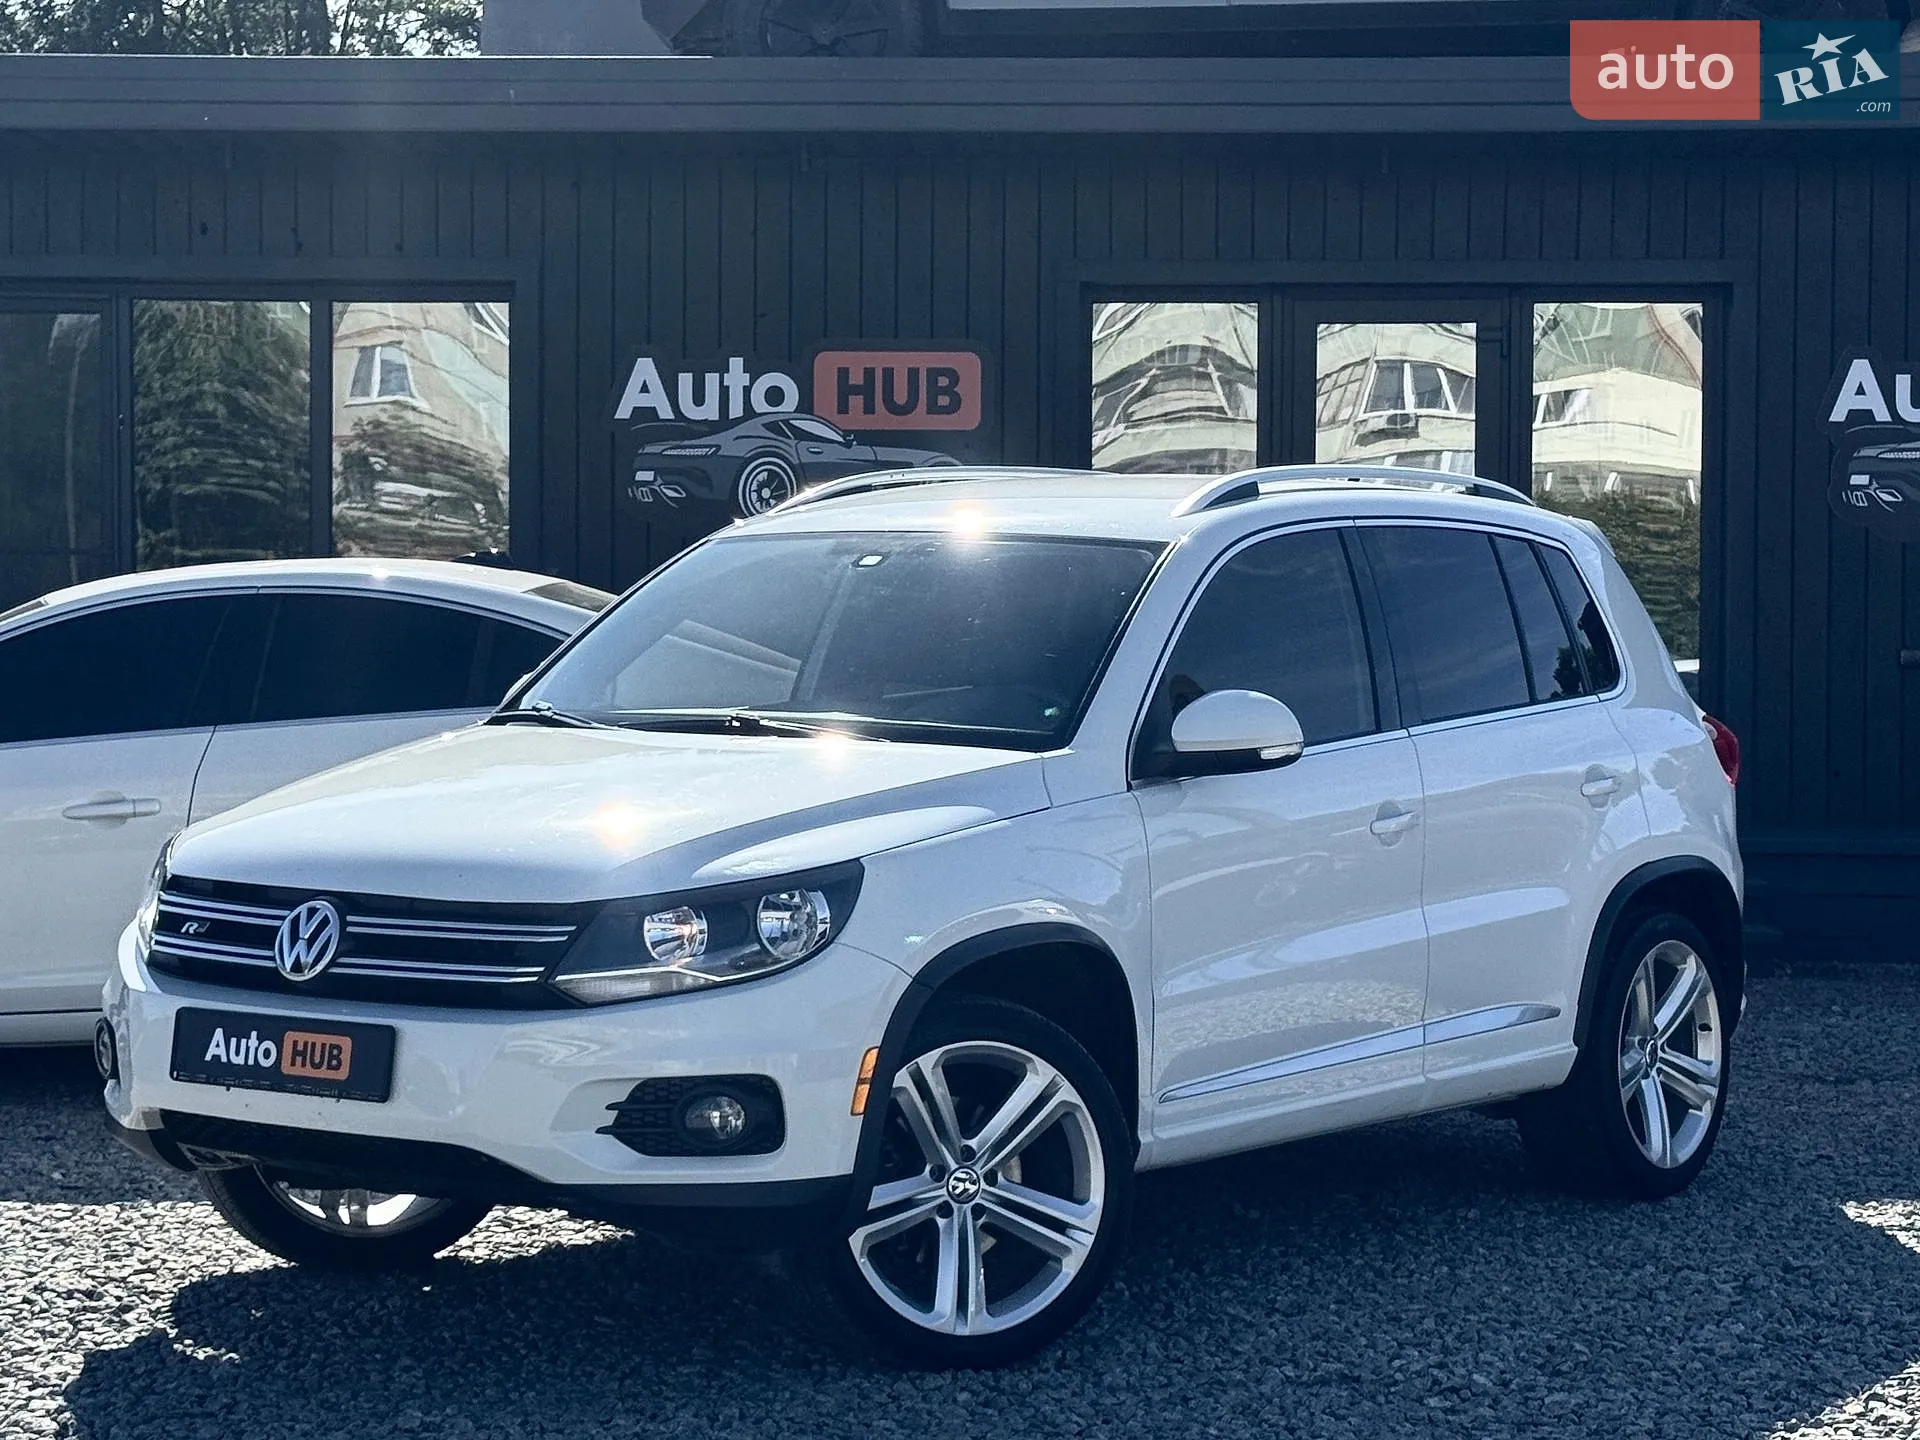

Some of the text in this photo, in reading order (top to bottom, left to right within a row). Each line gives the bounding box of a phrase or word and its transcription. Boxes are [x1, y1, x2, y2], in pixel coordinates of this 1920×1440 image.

[614, 357, 962, 421] Auto HUB
[204, 1028, 342, 1071] Auto HUB
